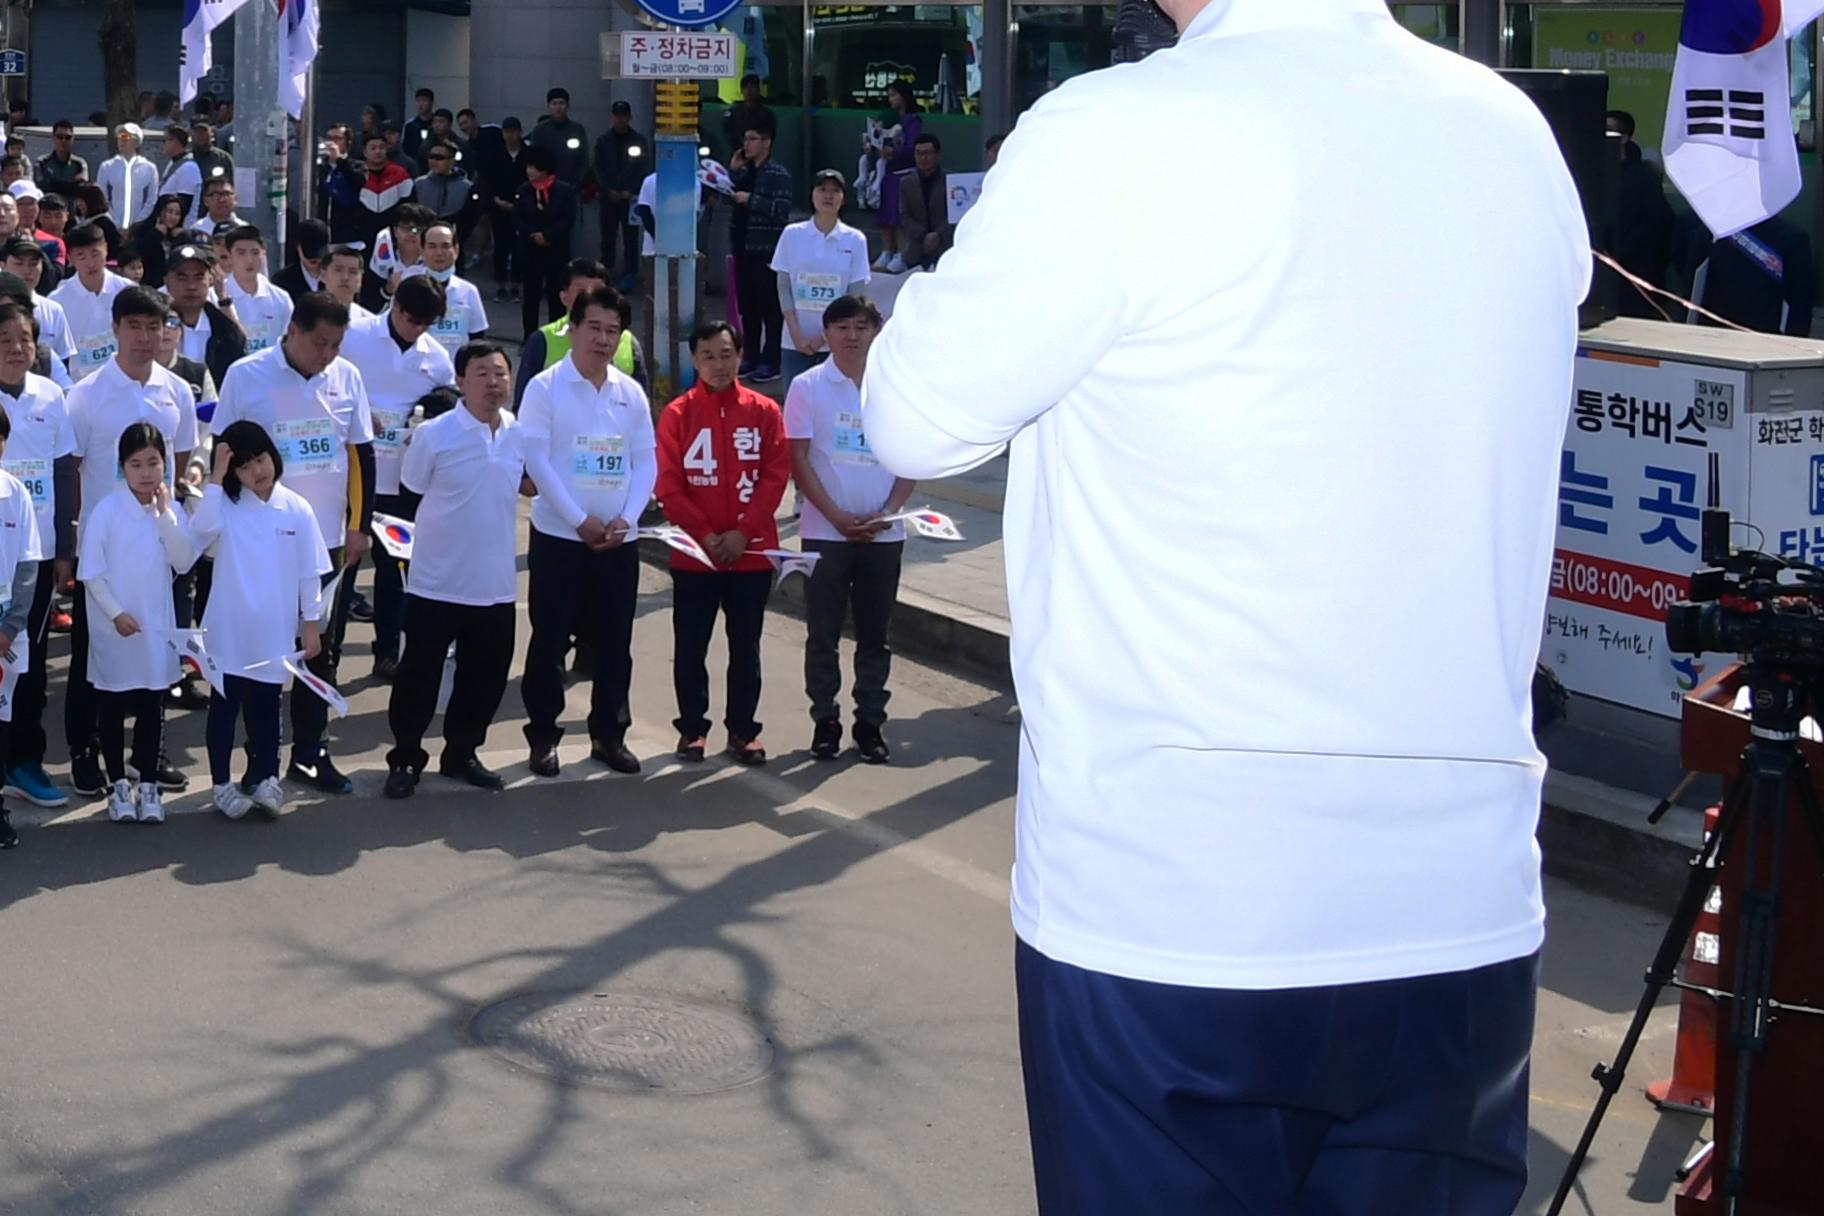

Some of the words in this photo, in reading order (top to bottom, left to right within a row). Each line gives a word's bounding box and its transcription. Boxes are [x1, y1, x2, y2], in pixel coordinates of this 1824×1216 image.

[3, 61, 17, 73] 32
[1606, 47, 1674, 71] Exchang
[1574, 389, 1708, 447] 통학버스
[1693, 397, 1727, 422] S19
[298, 437, 331, 455] 366
[683, 427, 718, 476] 4
[596, 455, 623, 471] 197
[1639, 464, 1700, 554] 곳
